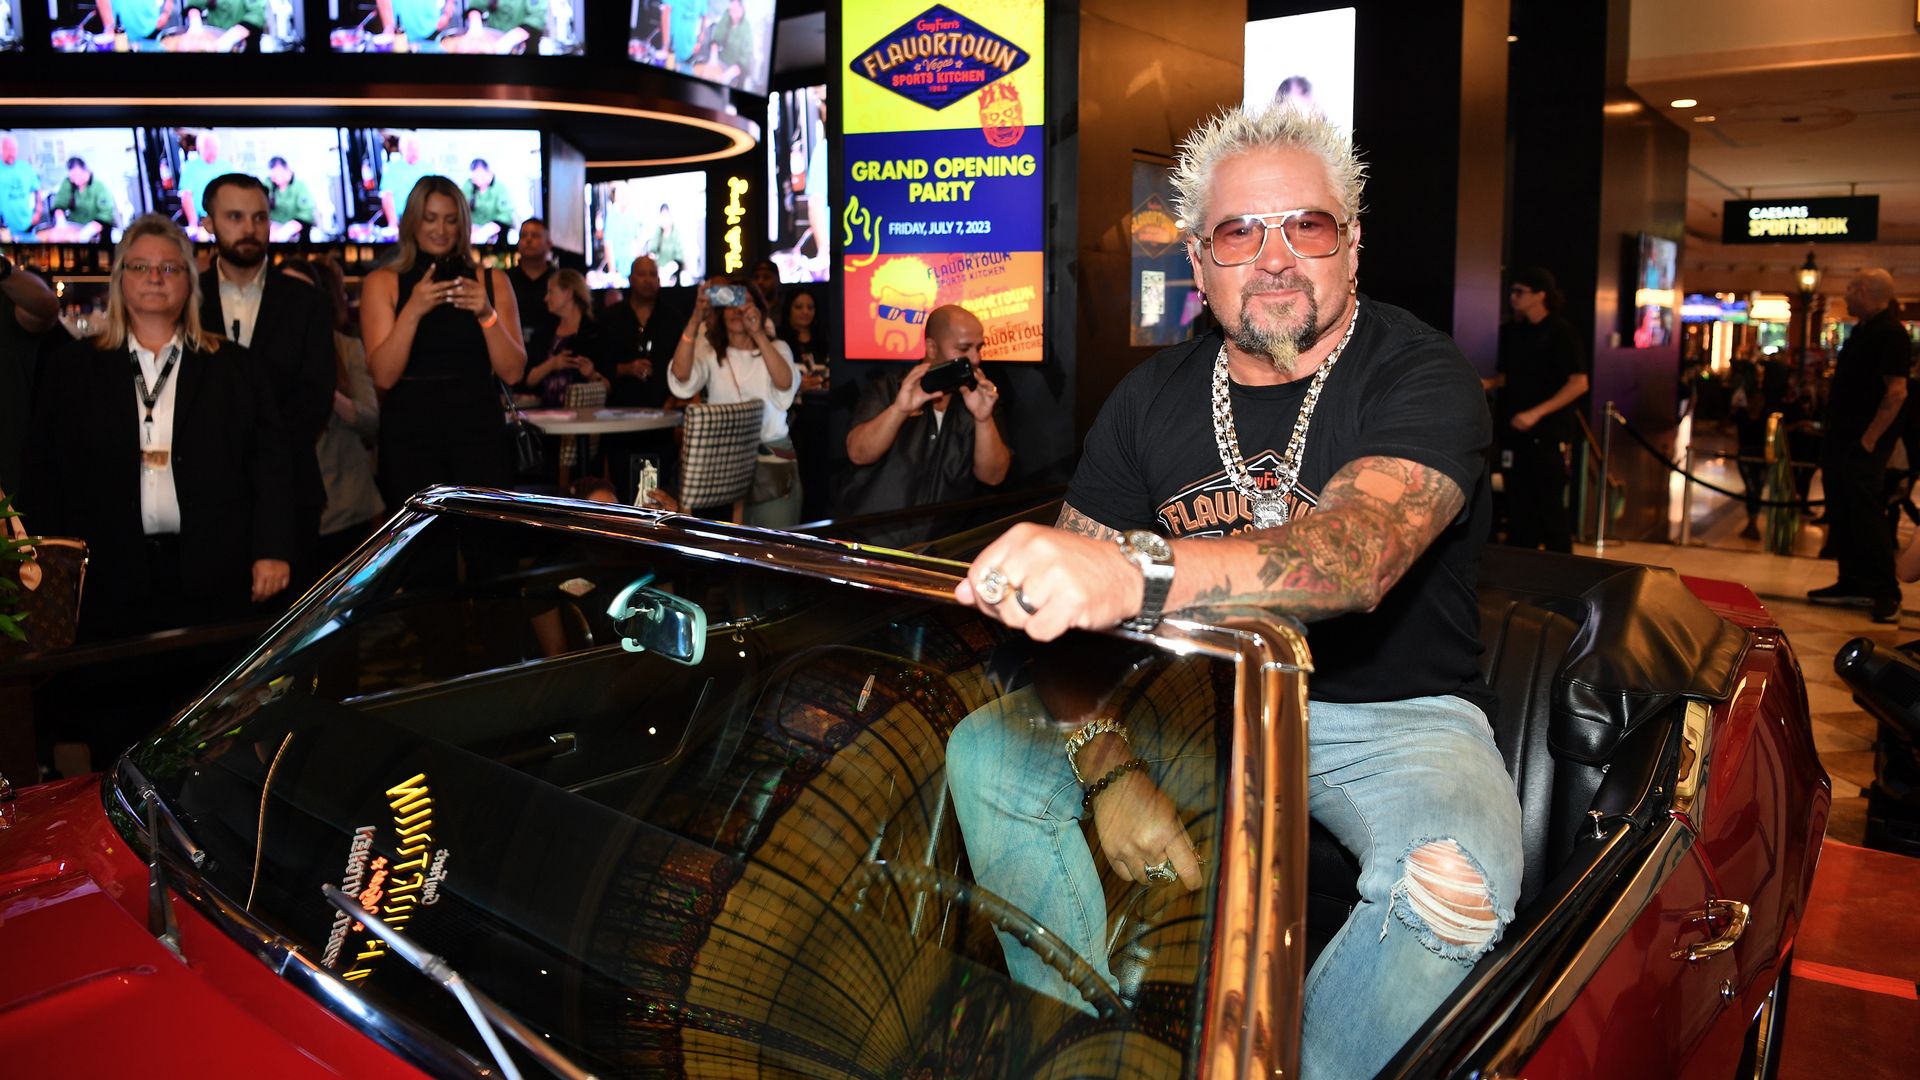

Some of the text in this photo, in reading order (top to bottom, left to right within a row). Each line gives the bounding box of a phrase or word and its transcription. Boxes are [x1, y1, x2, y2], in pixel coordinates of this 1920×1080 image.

[863, 32, 1018, 78] FLAVORTOWN
[923, 58, 953, 72] Vegas
[892, 70, 985, 87] SPORTS KITCHEN
[851, 154, 1036, 181] GRAND OPENING
[909, 181, 975, 203] PARTY
[1749, 206, 1808, 219] CAESARS
[889, 220, 991, 236] FRIDAY, JULY 7, 2023
[1748, 217, 1848, 237] SPORTSBOOK
